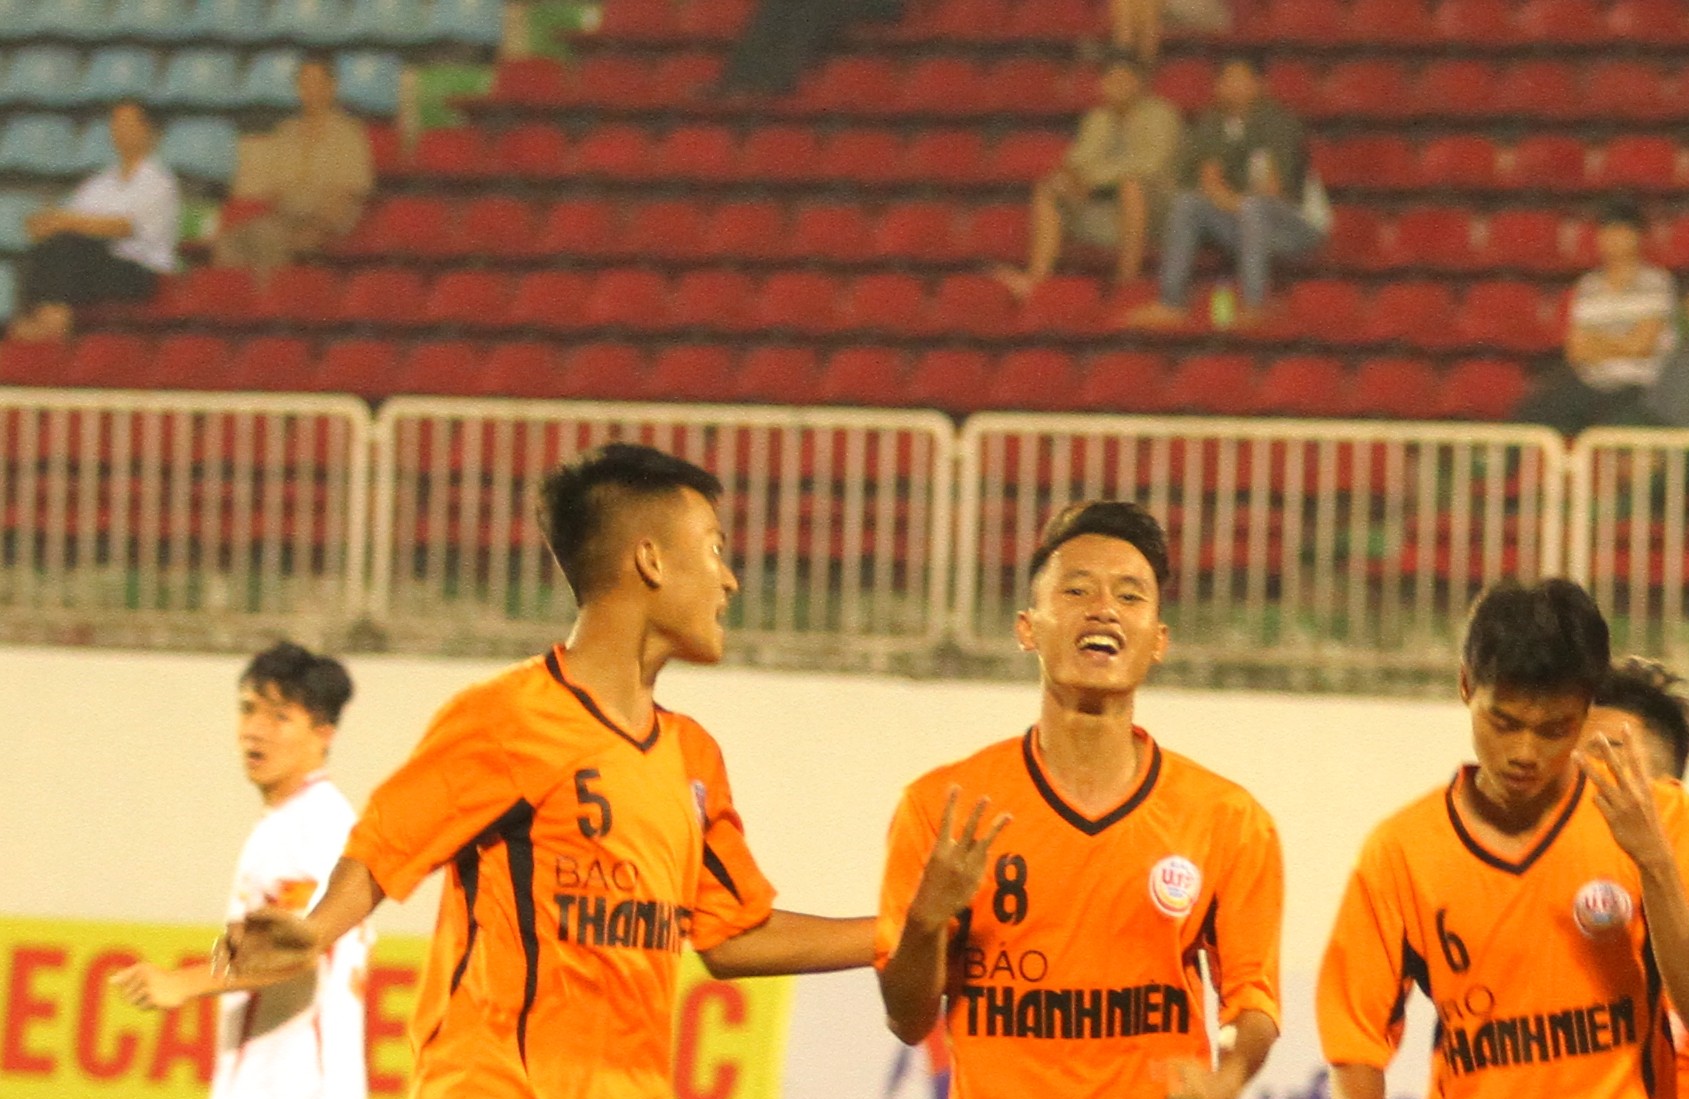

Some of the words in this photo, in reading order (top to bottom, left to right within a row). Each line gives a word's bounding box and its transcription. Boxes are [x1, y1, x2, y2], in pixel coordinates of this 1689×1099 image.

[574, 767, 613, 839] 5
[993, 852, 1029, 926] 8
[1435, 908, 1471, 974] 6
